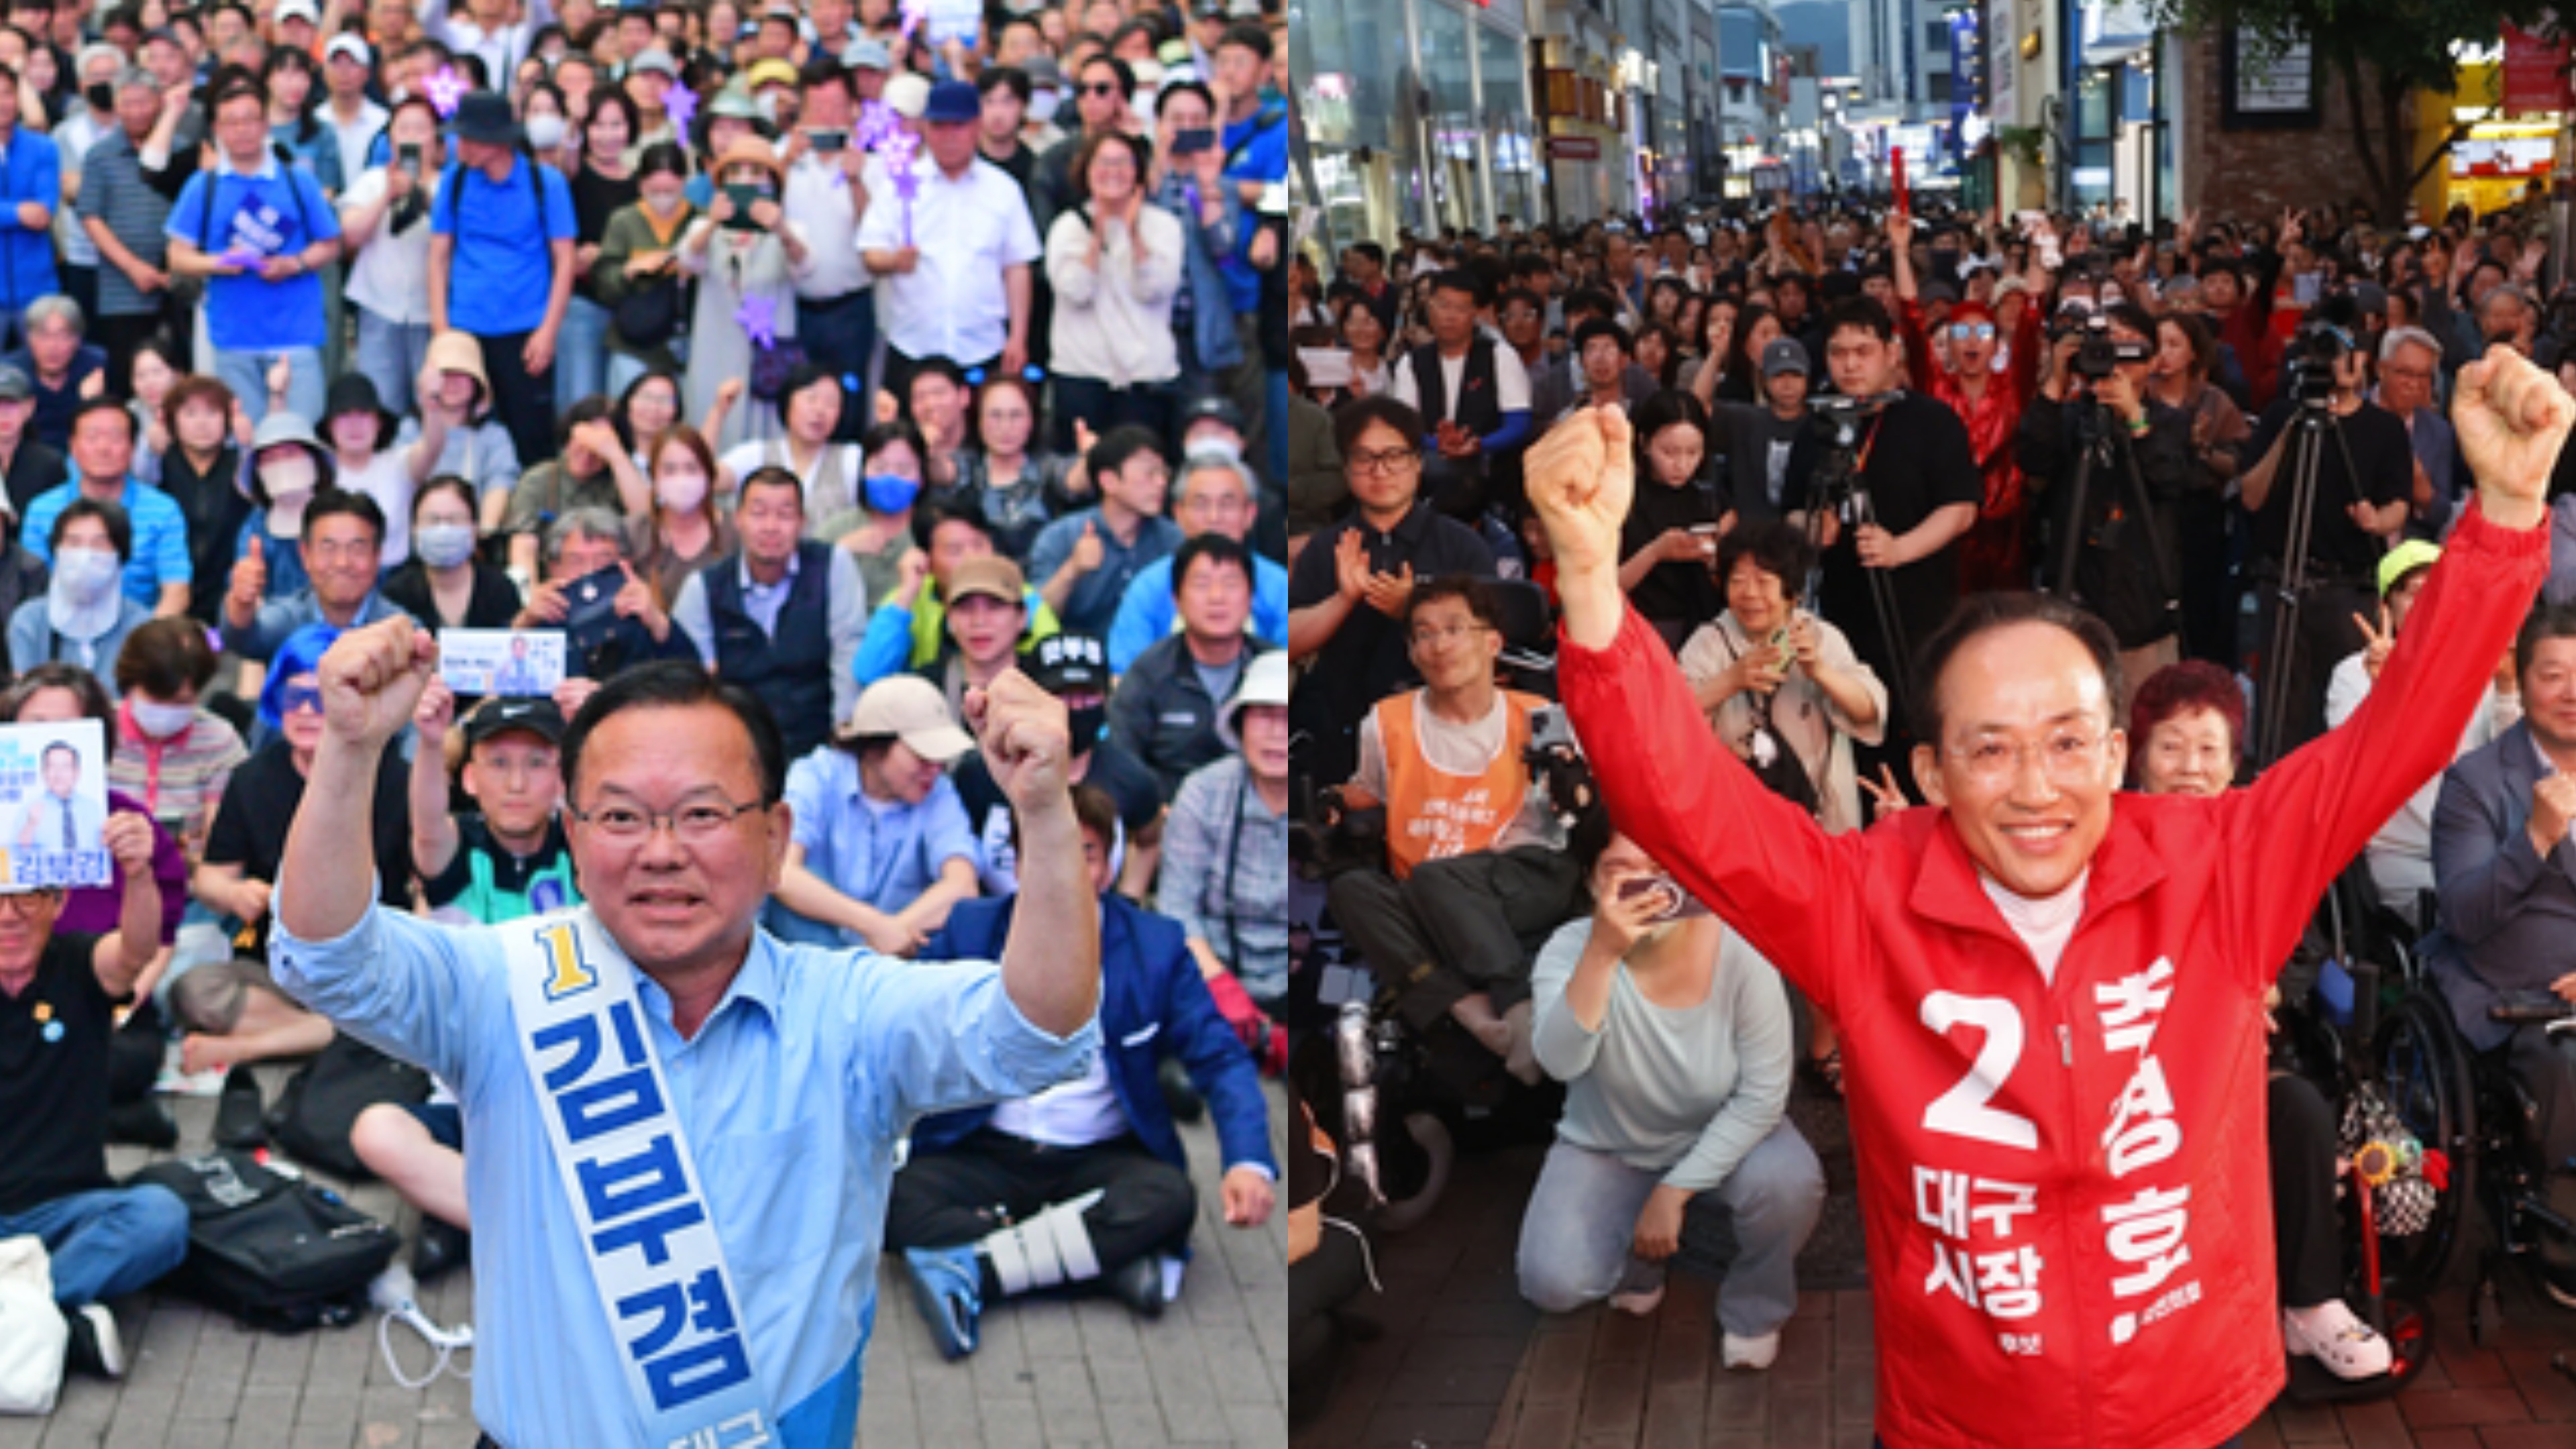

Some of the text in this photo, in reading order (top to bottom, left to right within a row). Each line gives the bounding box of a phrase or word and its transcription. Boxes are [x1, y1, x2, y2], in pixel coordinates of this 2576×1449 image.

[534, 922, 598, 1002] 1
[1919, 989, 2037, 1150] 2
[2094, 955, 2192, 1299] 추경호
[531, 1000, 752, 1412] 김부겸
[1912, 1165, 2038, 1240] 대구
[1925, 1242, 2044, 1318] 시장
